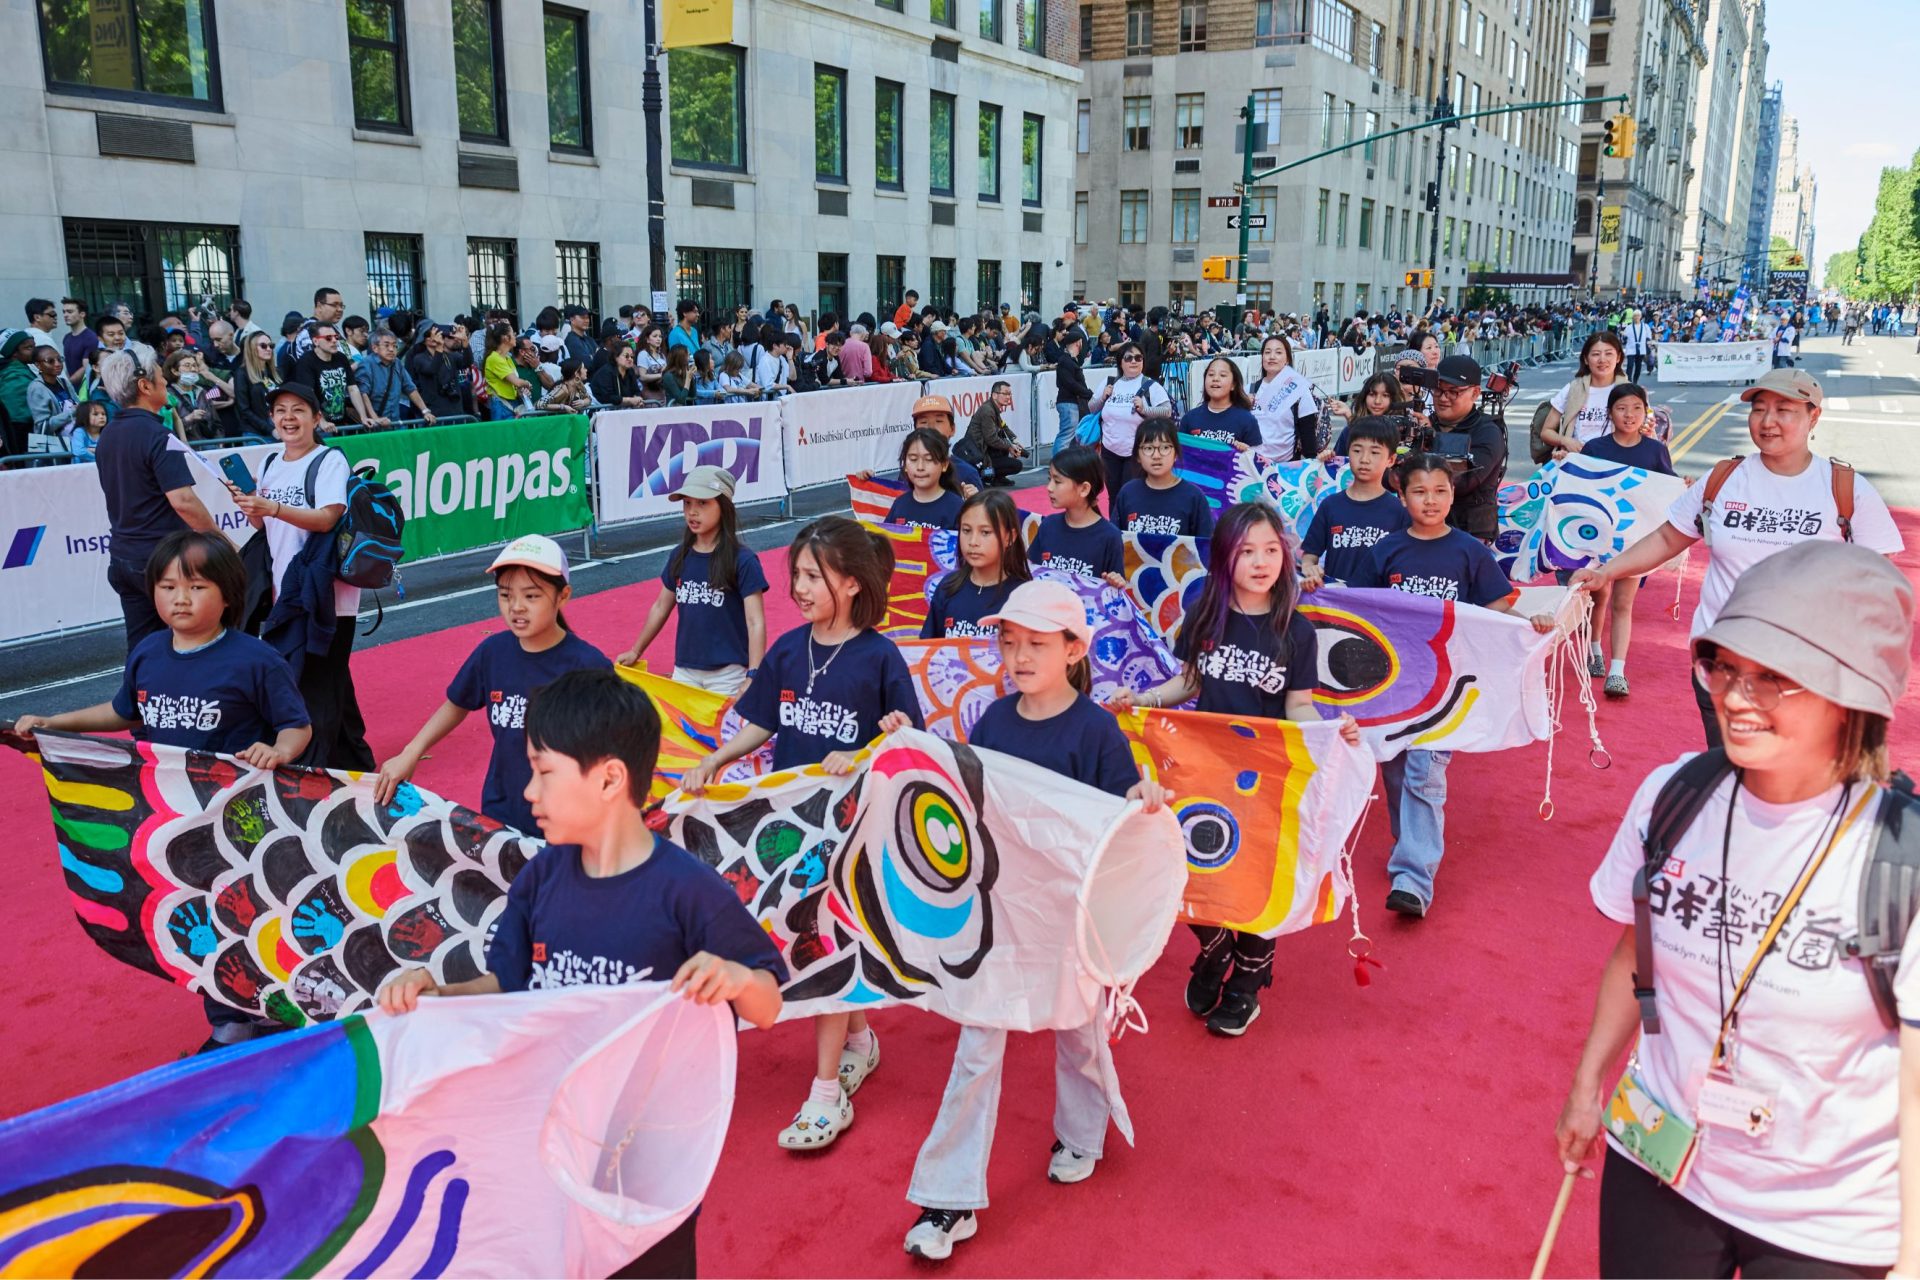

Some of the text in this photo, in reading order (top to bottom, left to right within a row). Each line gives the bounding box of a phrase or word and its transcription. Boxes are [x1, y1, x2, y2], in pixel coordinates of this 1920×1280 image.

[1215, 199, 1220, 207] W
[1221, 199, 1227, 207] 71
[1773, 271, 1806, 279] TOYAMA
[951, 391, 1015, 417] NOMA
[809, 428, 844, 445] Mitsubishi
[844, 424, 882, 441] Corporation
[628, 417, 763, 500] KDDI
[1725, 501, 1747, 511] BNG
